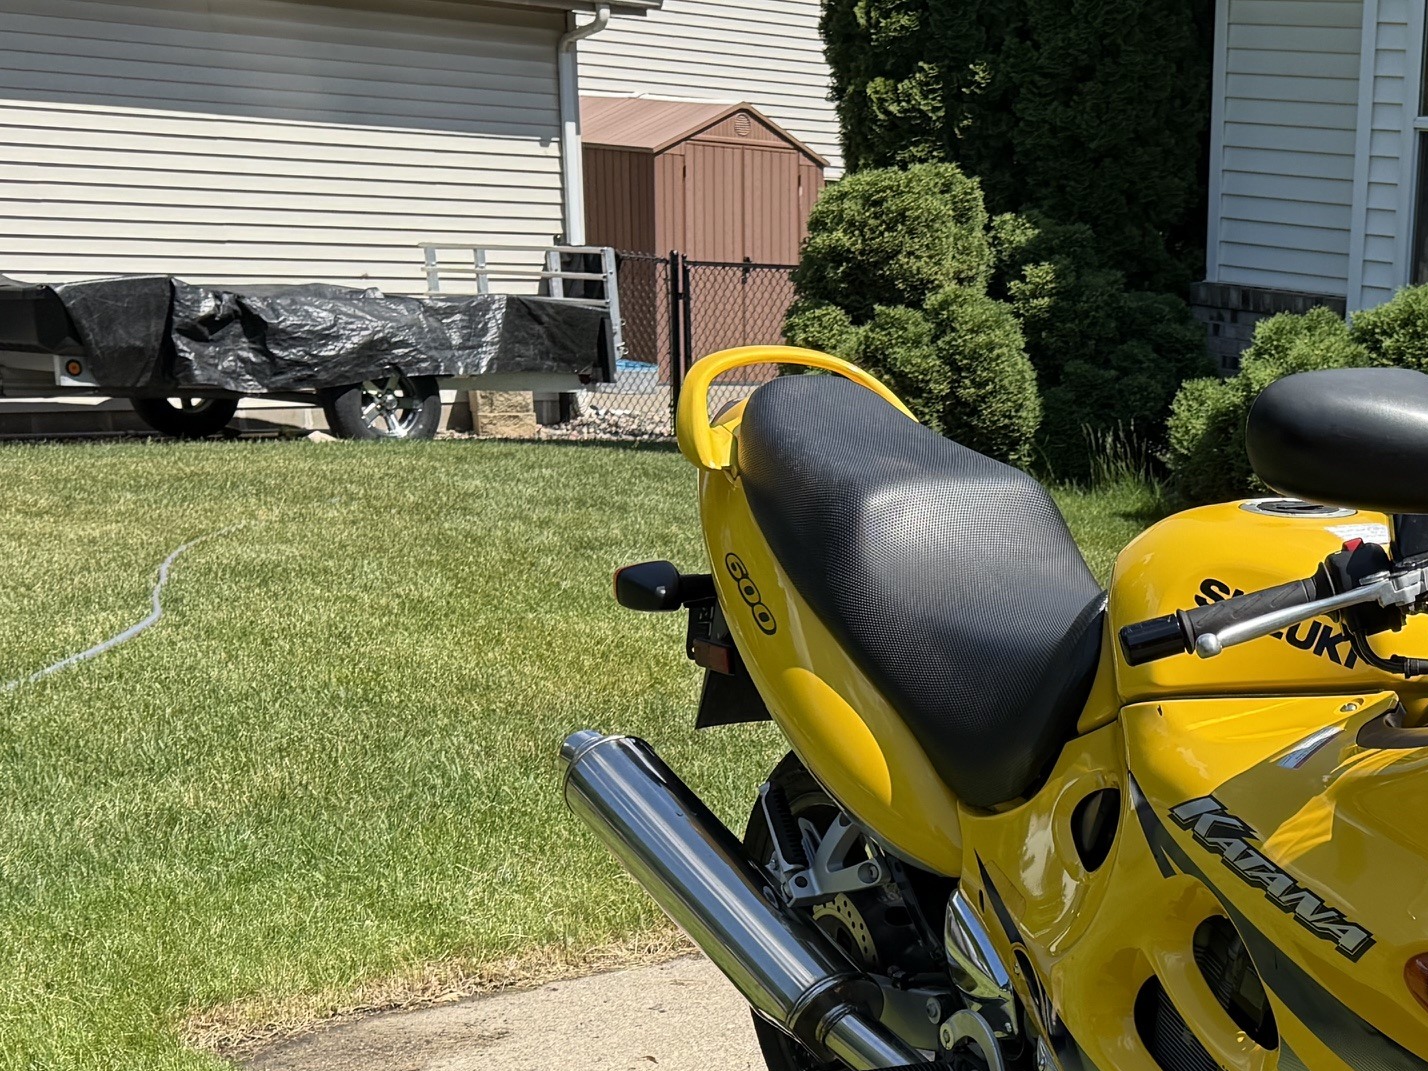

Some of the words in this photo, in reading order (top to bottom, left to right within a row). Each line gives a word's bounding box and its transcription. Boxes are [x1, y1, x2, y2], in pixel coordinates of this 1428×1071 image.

[725, 552, 778, 636] 600
[1194, 578, 1358, 669] SUKI
[1168, 795, 1376, 962] KATANA
